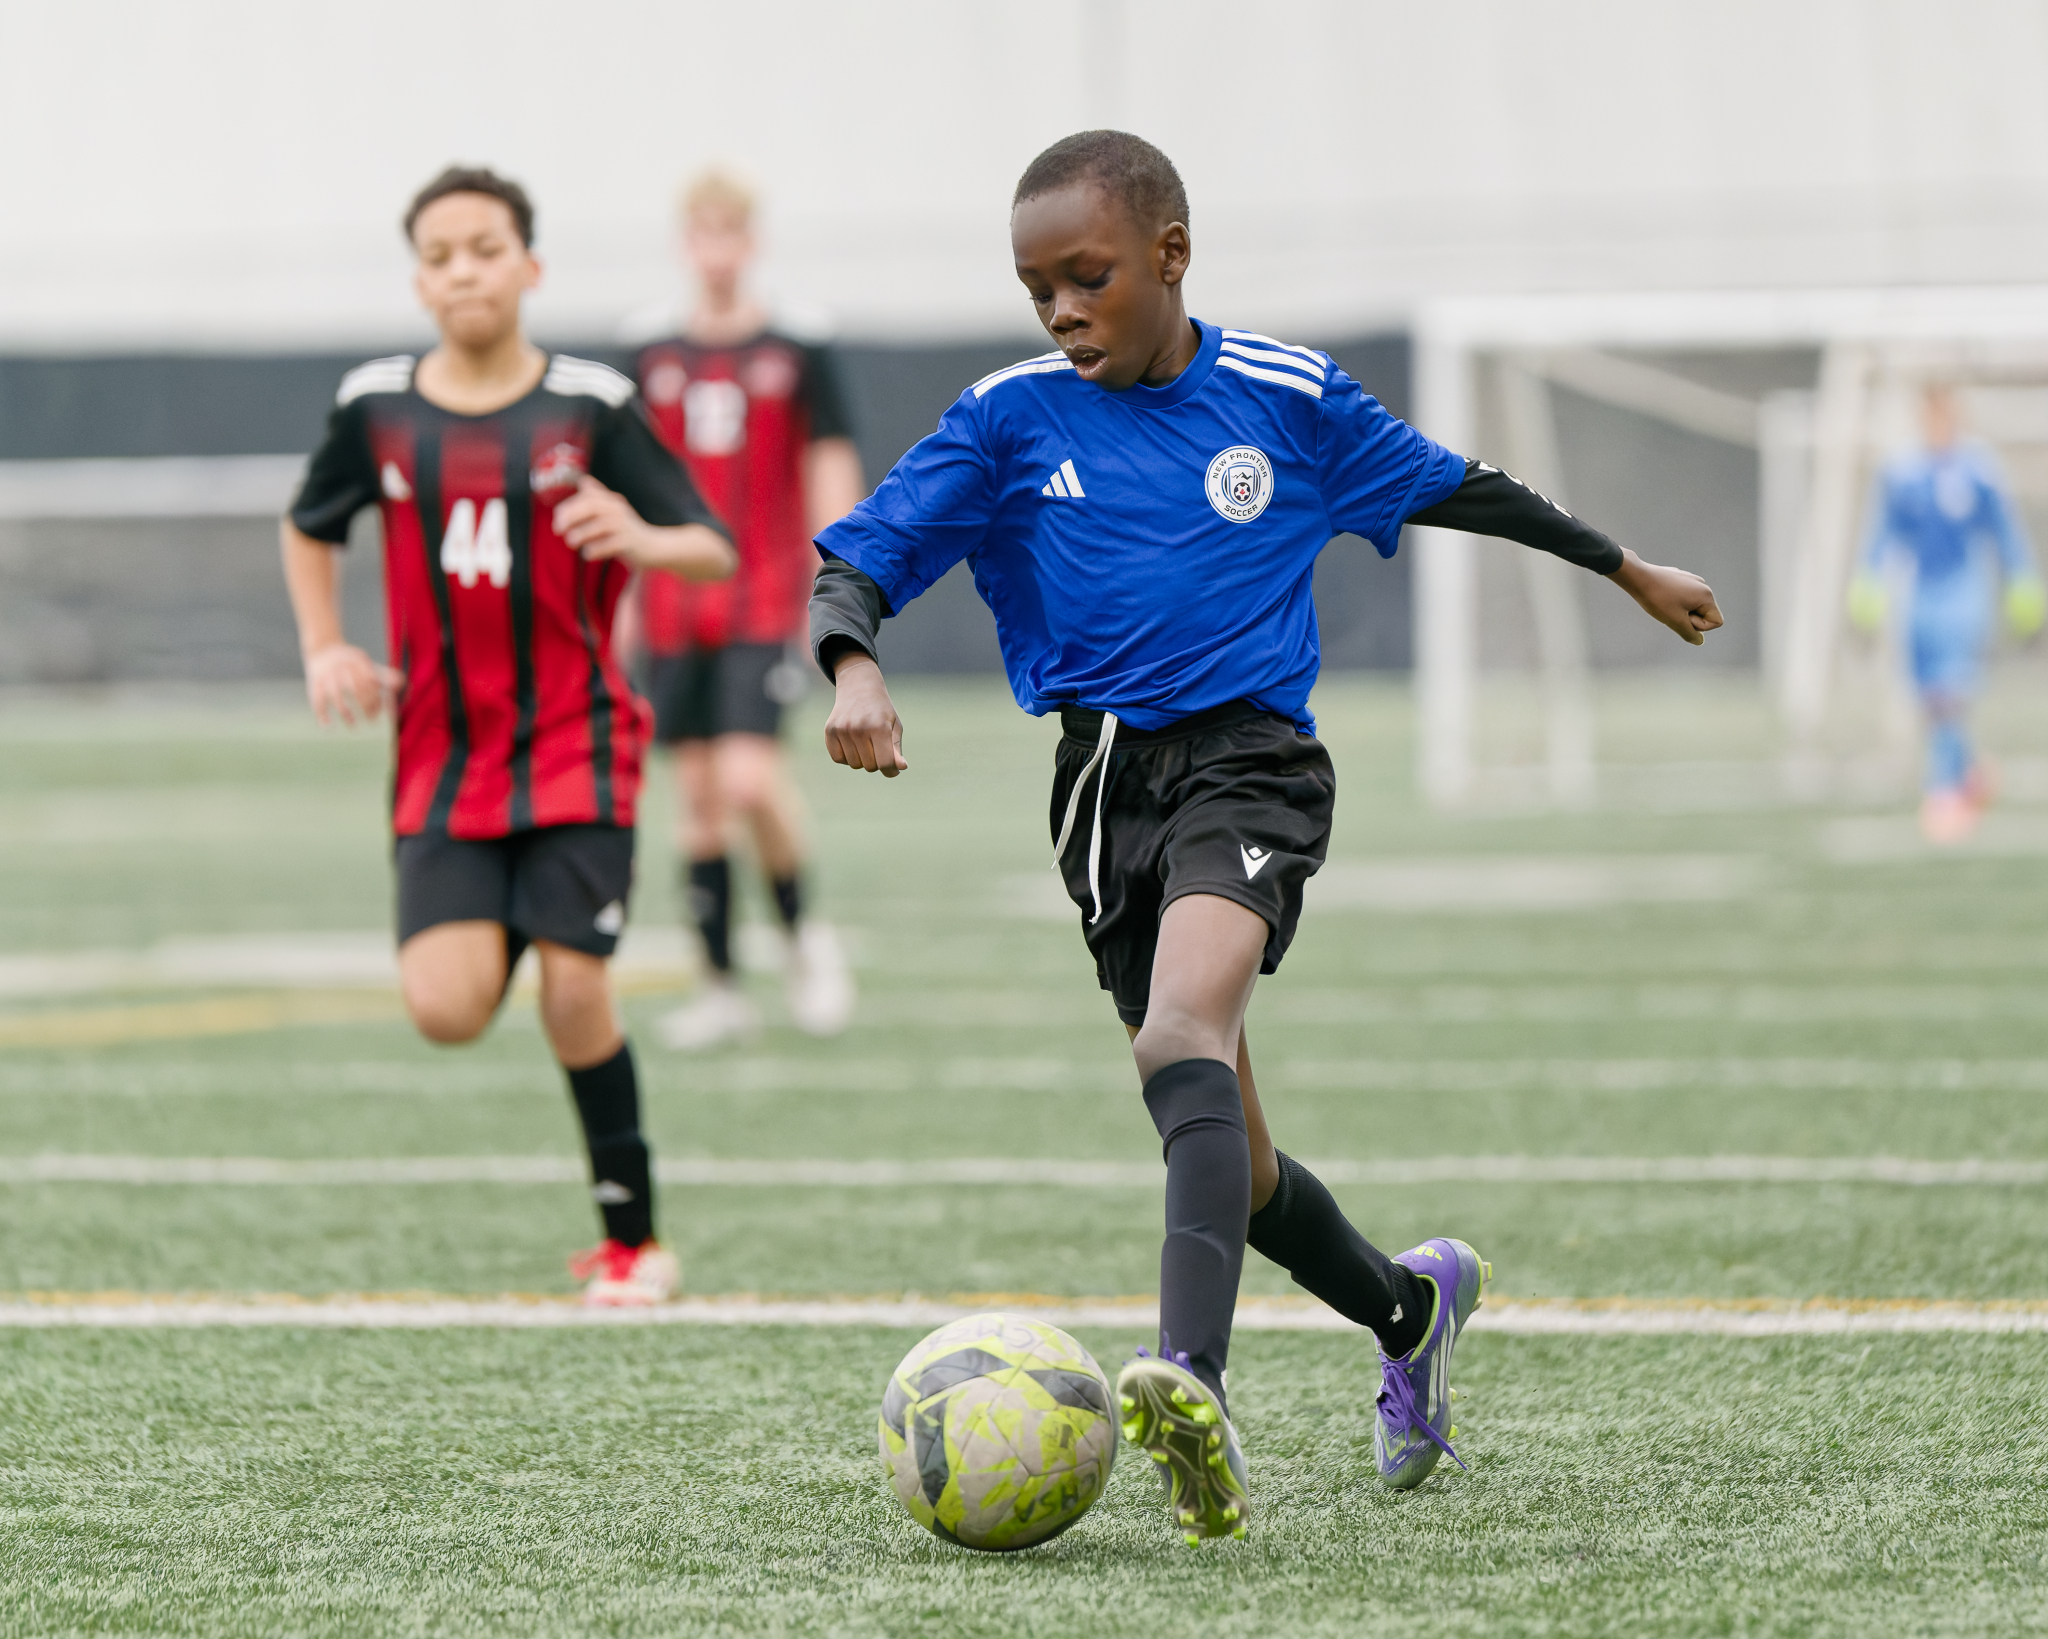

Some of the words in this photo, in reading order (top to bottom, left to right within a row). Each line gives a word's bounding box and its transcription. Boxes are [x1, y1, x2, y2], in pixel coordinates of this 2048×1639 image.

[1212, 458, 1227, 479] NEW
[1229, 452, 1268, 478] FRONTIER
[1223, 504, 1258, 517] SOCCER
[440, 498, 513, 589] 44
